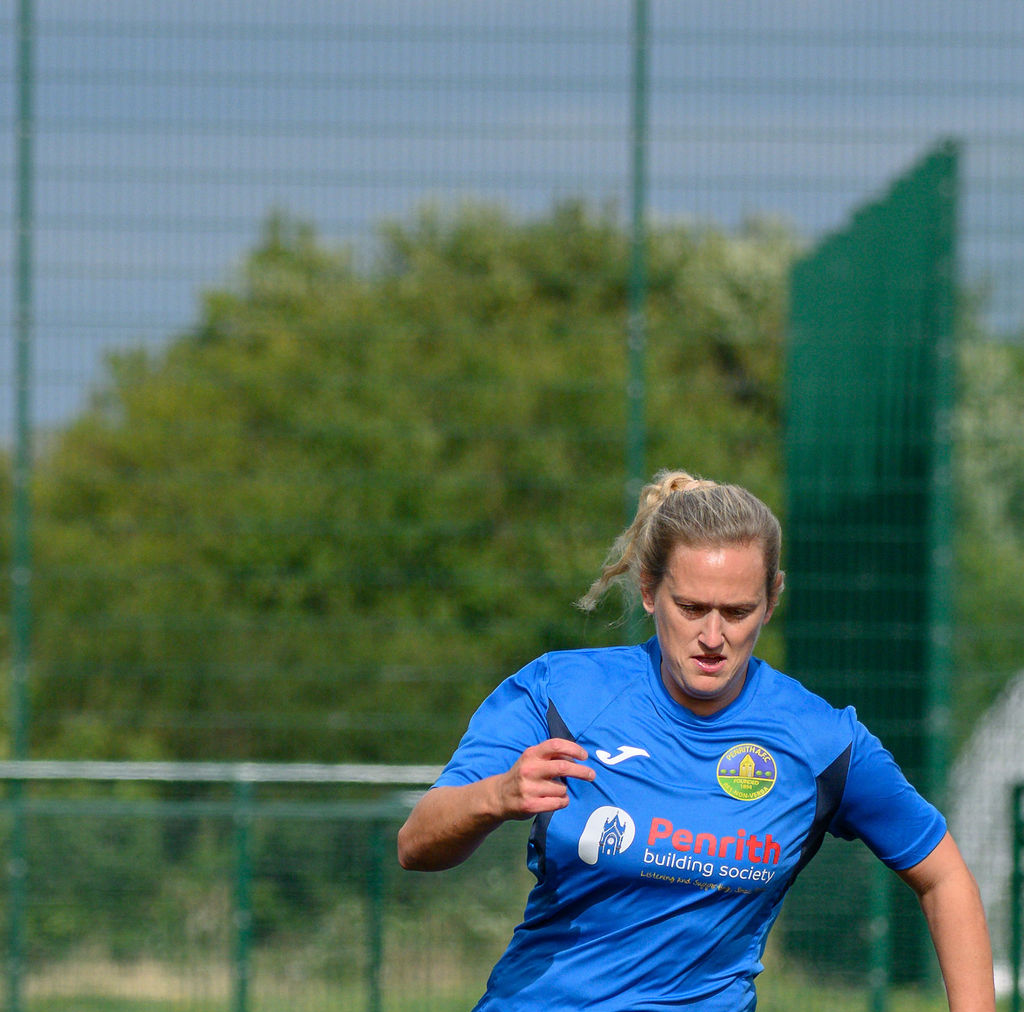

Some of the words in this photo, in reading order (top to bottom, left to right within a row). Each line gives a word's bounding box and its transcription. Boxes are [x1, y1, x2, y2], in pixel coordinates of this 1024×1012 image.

[726, 745, 755, 760] PENRITH
[647, 817, 782, 865] Penrith
[640, 870, 675, 883] Listening
[643, 848, 714, 877] building
[718, 865, 775, 884] society
